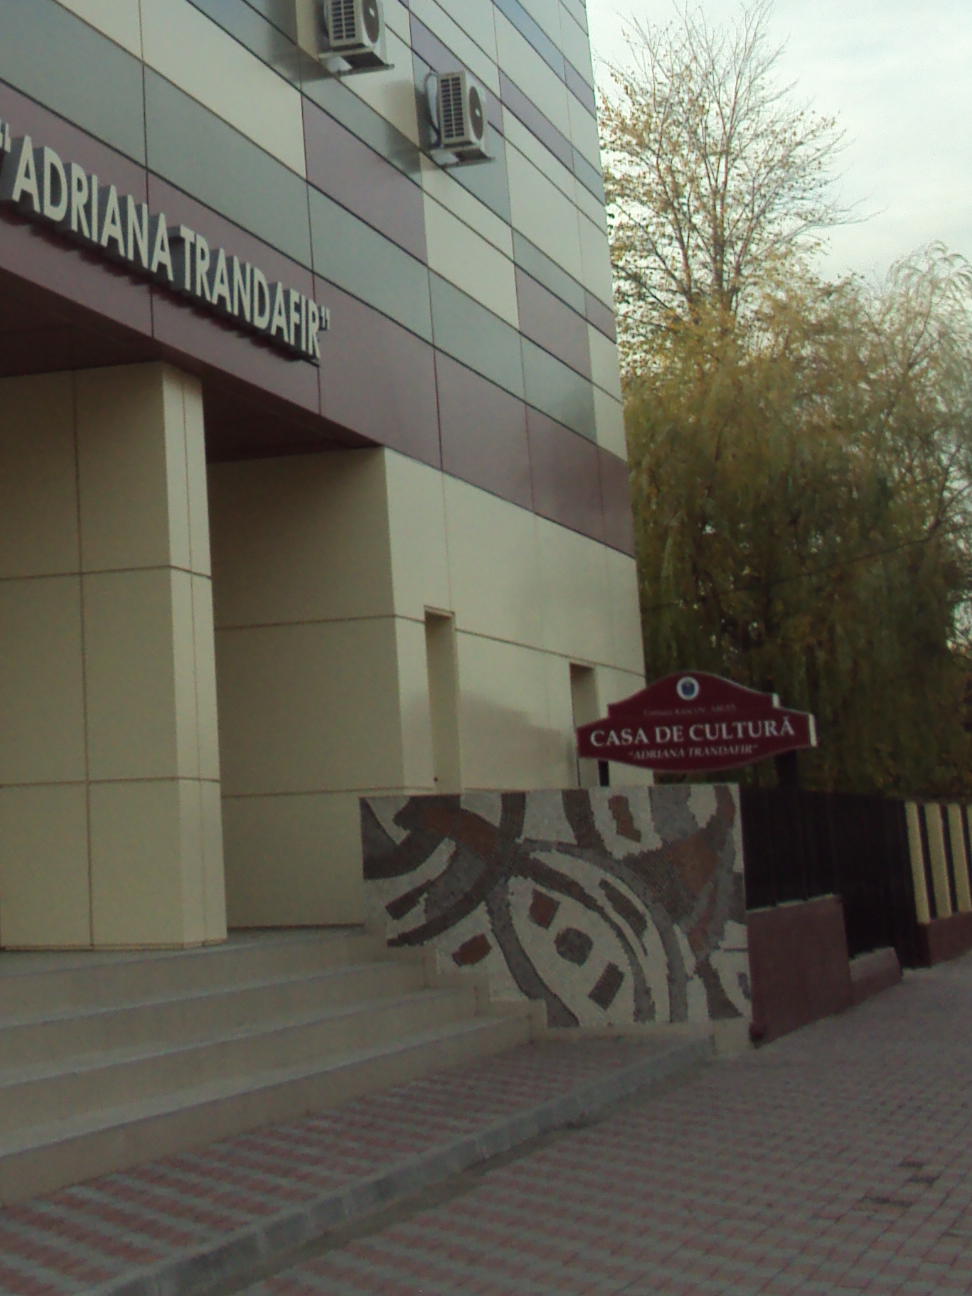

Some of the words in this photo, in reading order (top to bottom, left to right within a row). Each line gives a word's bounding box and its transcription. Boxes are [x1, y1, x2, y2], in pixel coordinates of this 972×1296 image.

[590, 727, 649, 747] CASA
[655, 725, 684, 743] DE
[689, 716, 796, 741] CULTURĂ
